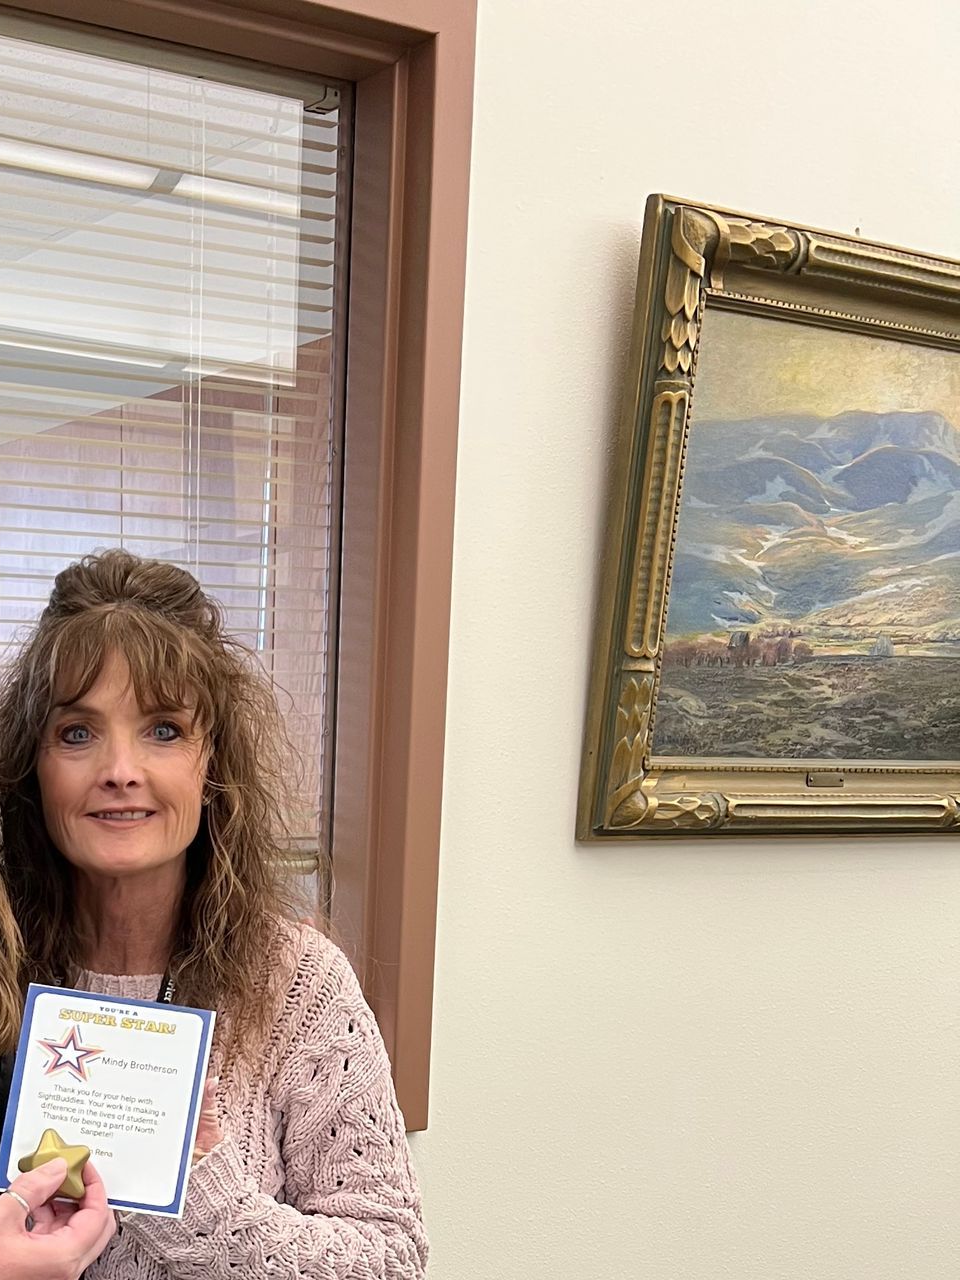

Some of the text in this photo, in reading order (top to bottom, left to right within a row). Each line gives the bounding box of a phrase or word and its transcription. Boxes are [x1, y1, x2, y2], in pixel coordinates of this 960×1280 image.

[99, 1006, 130, 1015] YOU'RE
[58, 1008, 177, 1035] SUPER STAR!
[101, 1057, 178, 1075] Mindy Brotherson
[54, 1084, 75, 1093] Thank
[77, 1089, 90, 1097] you
[92, 1089, 101, 1097] for
[121, 1094, 136, 1104] help
[40, 1102, 77, 1113] difference
[99, 1110, 115, 1119] lives
[89, 1099, 104, 1107] Your
[133, 1107, 159, 1117] making
[43, 1111, 68, 1121] Thanks
[70, 1115, 80, 1123] for
[81, 1118, 101, 1128] being
[135, 1125, 155, 1134] North
[95, 1148, 113, 1158] Rena
